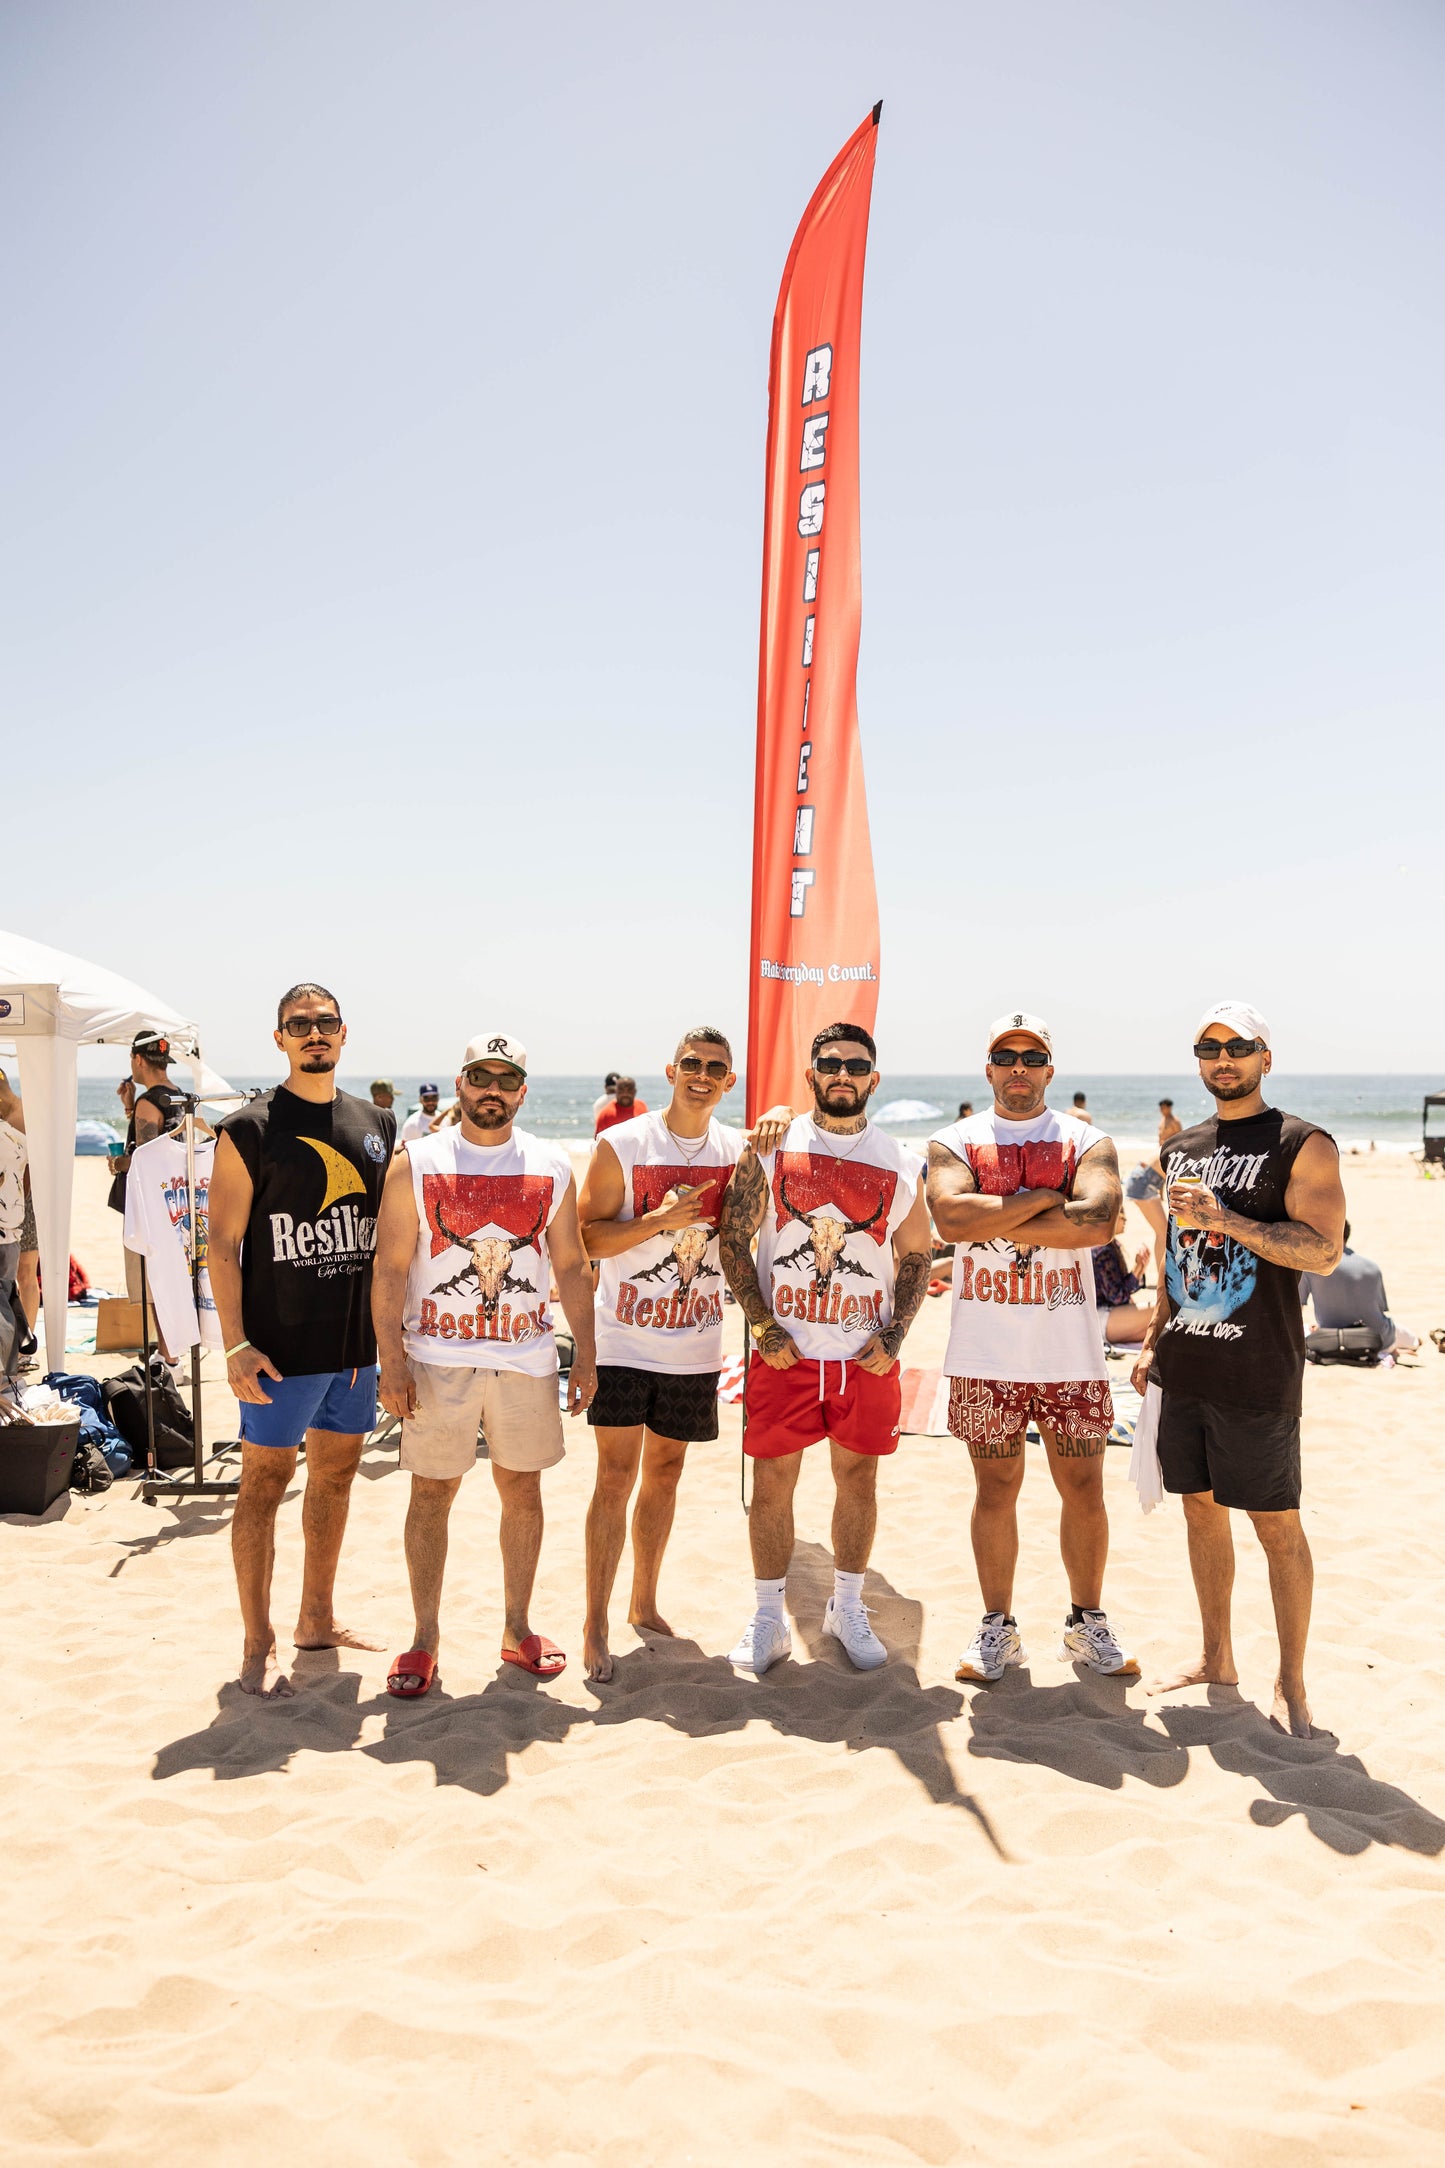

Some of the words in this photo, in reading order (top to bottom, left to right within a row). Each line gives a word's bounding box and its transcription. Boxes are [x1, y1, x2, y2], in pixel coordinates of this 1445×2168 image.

[790, 342, 833, 918] RESIENT
[827, 962, 878, 982] Count.
[487, 1038, 513, 1058] R
[292, 1253, 349, 1268] WORLDWIDE
[770, 1272, 884, 1328] esilient
[1047, 1284, 1084, 1311] Club
[841, 1310, 881, 1333] Club
[1185, 1319, 1211, 1337] ALL
[1213, 1322, 1247, 1341] ODDS
[970, 1434, 1022, 1459] ORALES
